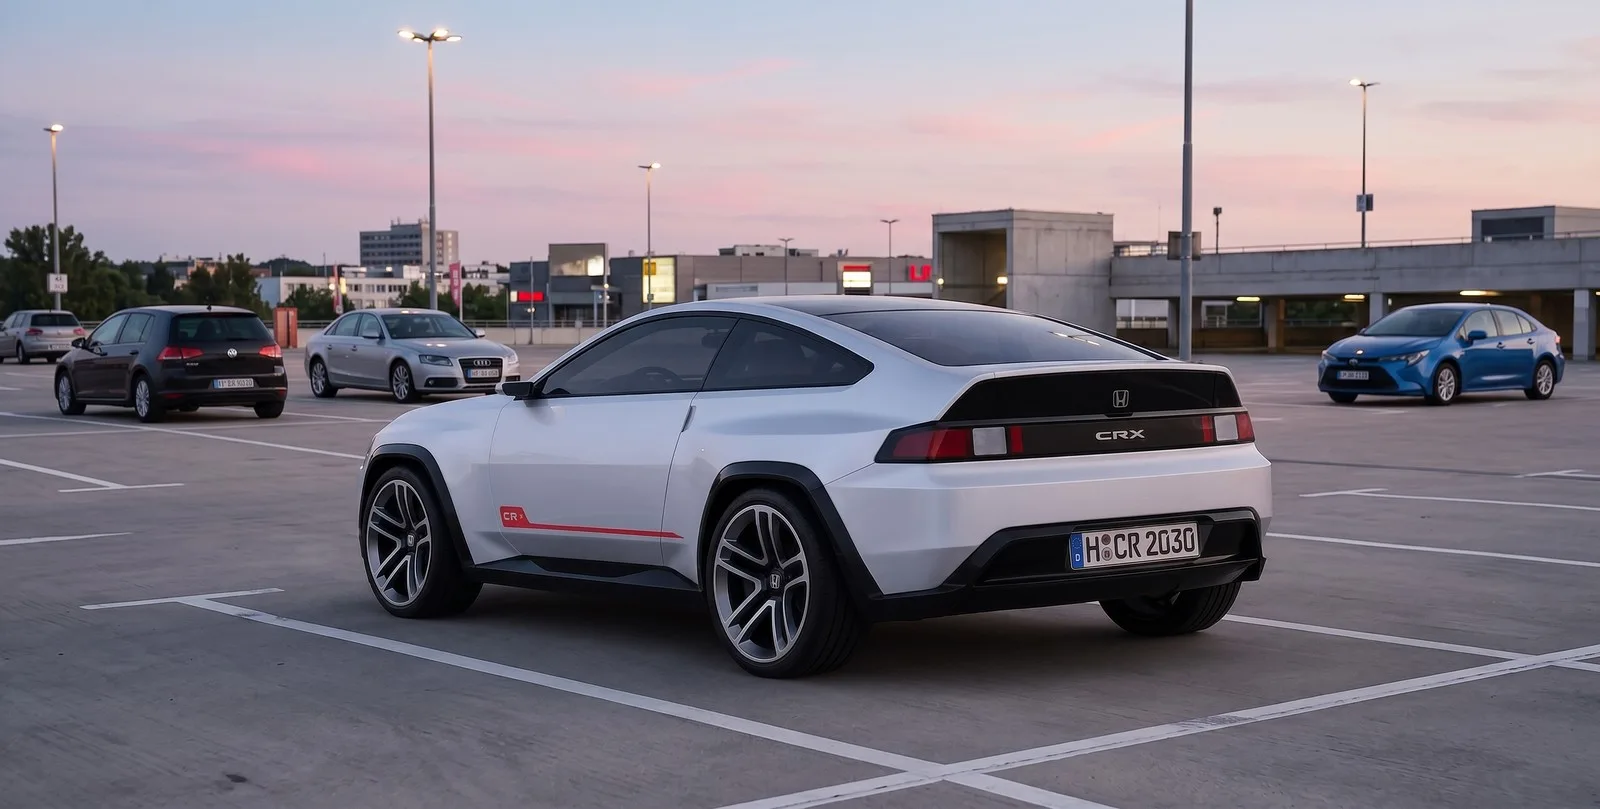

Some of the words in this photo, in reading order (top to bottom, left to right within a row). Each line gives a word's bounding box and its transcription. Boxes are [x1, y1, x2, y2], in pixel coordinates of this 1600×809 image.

[1095, 430, 1145, 440] CRX
[1085, 536, 1100, 563] H
[1113, 532, 1141, 559] CR
[1145, 527, 1195, 556] 2030
[1075, 553, 1081, 562] D
